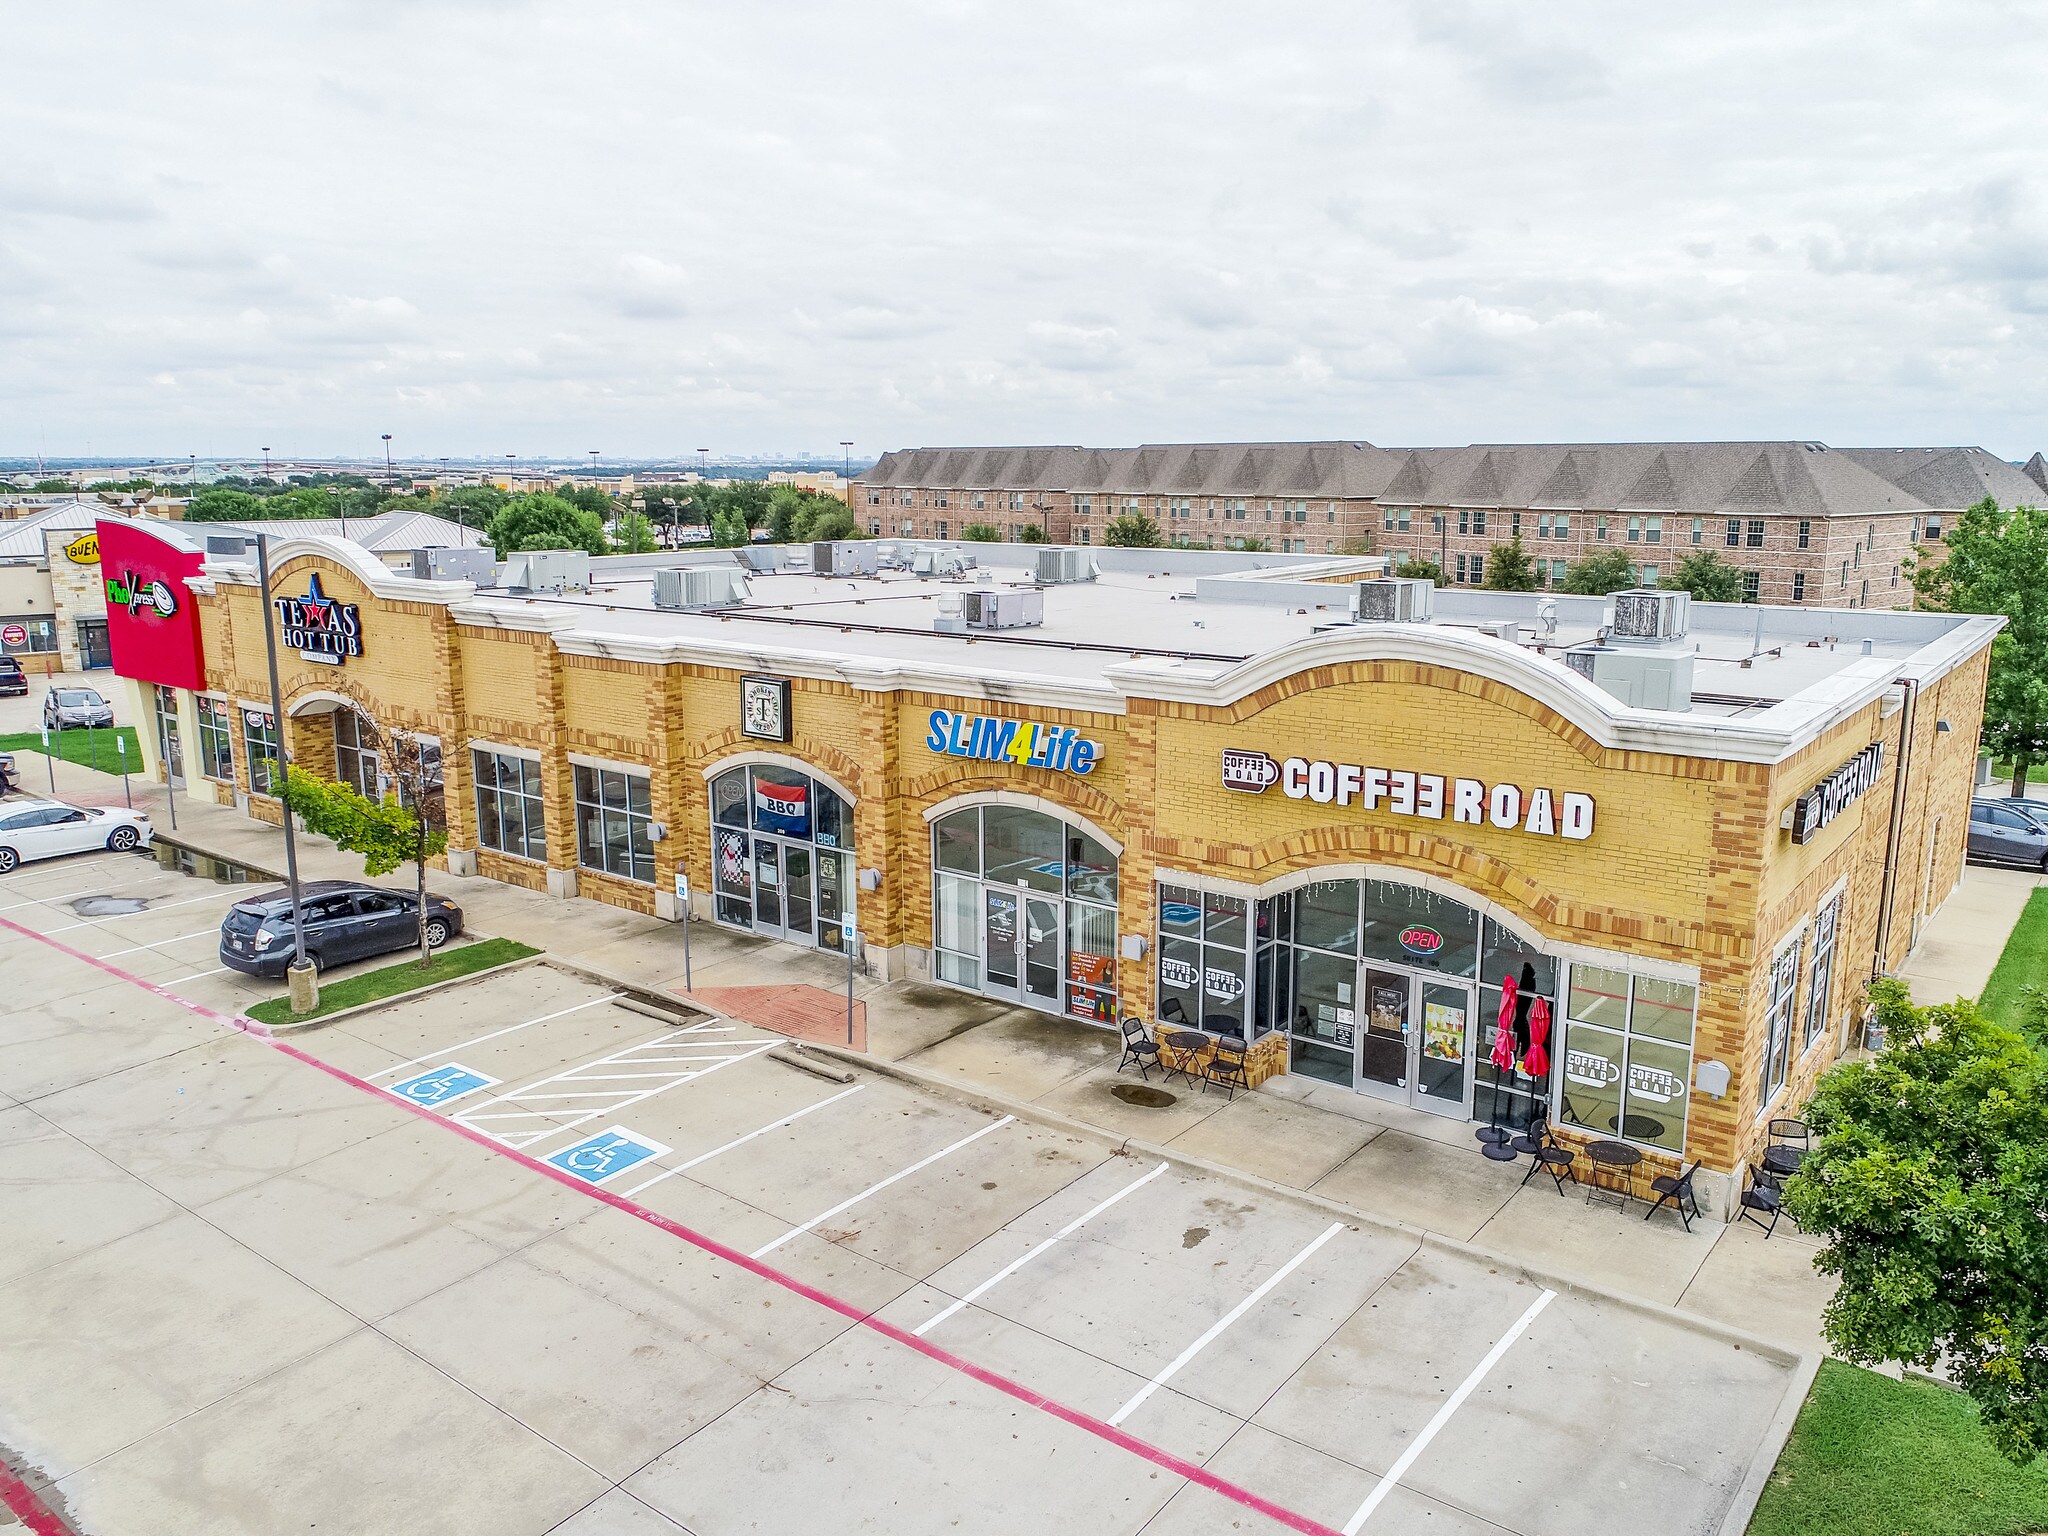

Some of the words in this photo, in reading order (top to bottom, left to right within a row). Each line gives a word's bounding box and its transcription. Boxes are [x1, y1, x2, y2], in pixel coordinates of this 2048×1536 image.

[70, 541, 100, 557] BUEN
[106, 579, 129, 604] Pho
[274, 598, 357, 637] TEXAS
[281, 628, 315, 650] HOT
[319, 633, 358, 656] TUB
[926, 710, 1096, 775] SLIM4Life
[1224, 769, 1264, 782] ROAD
[723, 784, 744, 797] OPEN
[767, 798, 796, 815] BBQ
[1454, 778, 1595, 840] ROAD
[1401, 930, 1440, 949] OPEN
[1161, 968, 1191, 983] ROAD
[1205, 979, 1236, 993] ROAD
[1566, 1063, 1607, 1081] ROAD
[1629, 1077, 1671, 1096] ROAD
